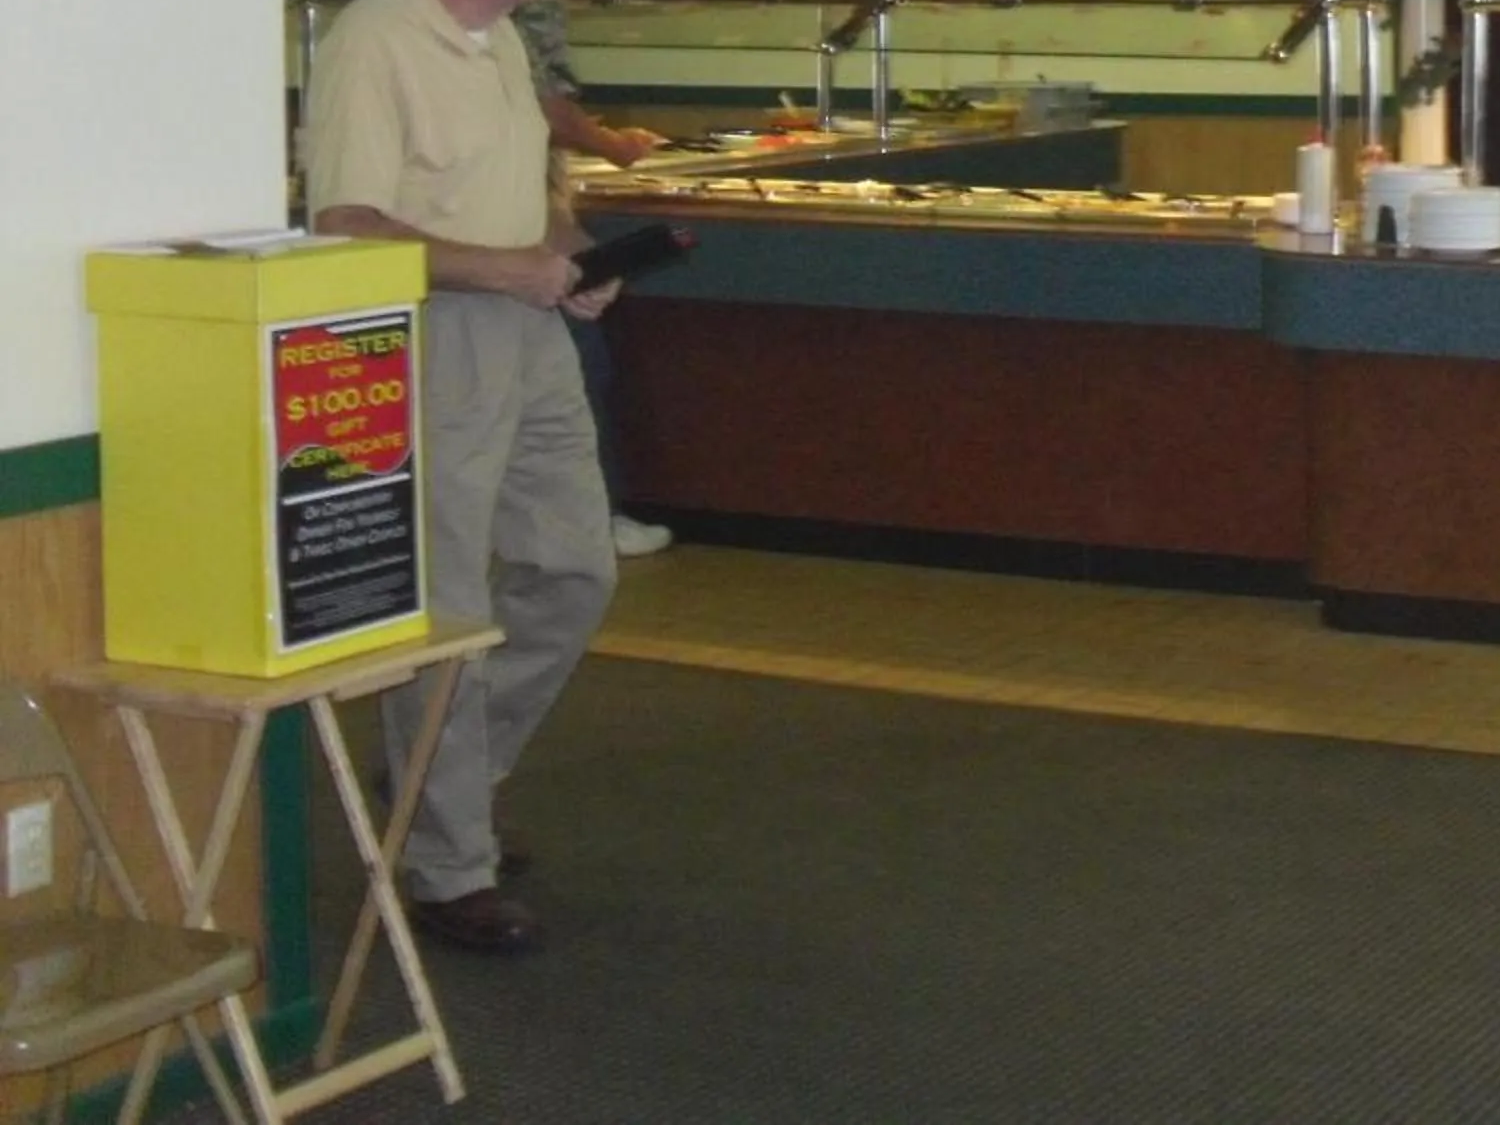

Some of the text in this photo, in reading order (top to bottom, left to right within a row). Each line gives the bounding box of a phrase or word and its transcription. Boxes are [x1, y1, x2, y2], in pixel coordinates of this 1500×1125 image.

[281, 331, 405, 368] REGISTER
[287, 380, 404, 421] $100.00
[326, 416, 368, 437] GIFT
[290, 432, 404, 467] CERTIFICATE
